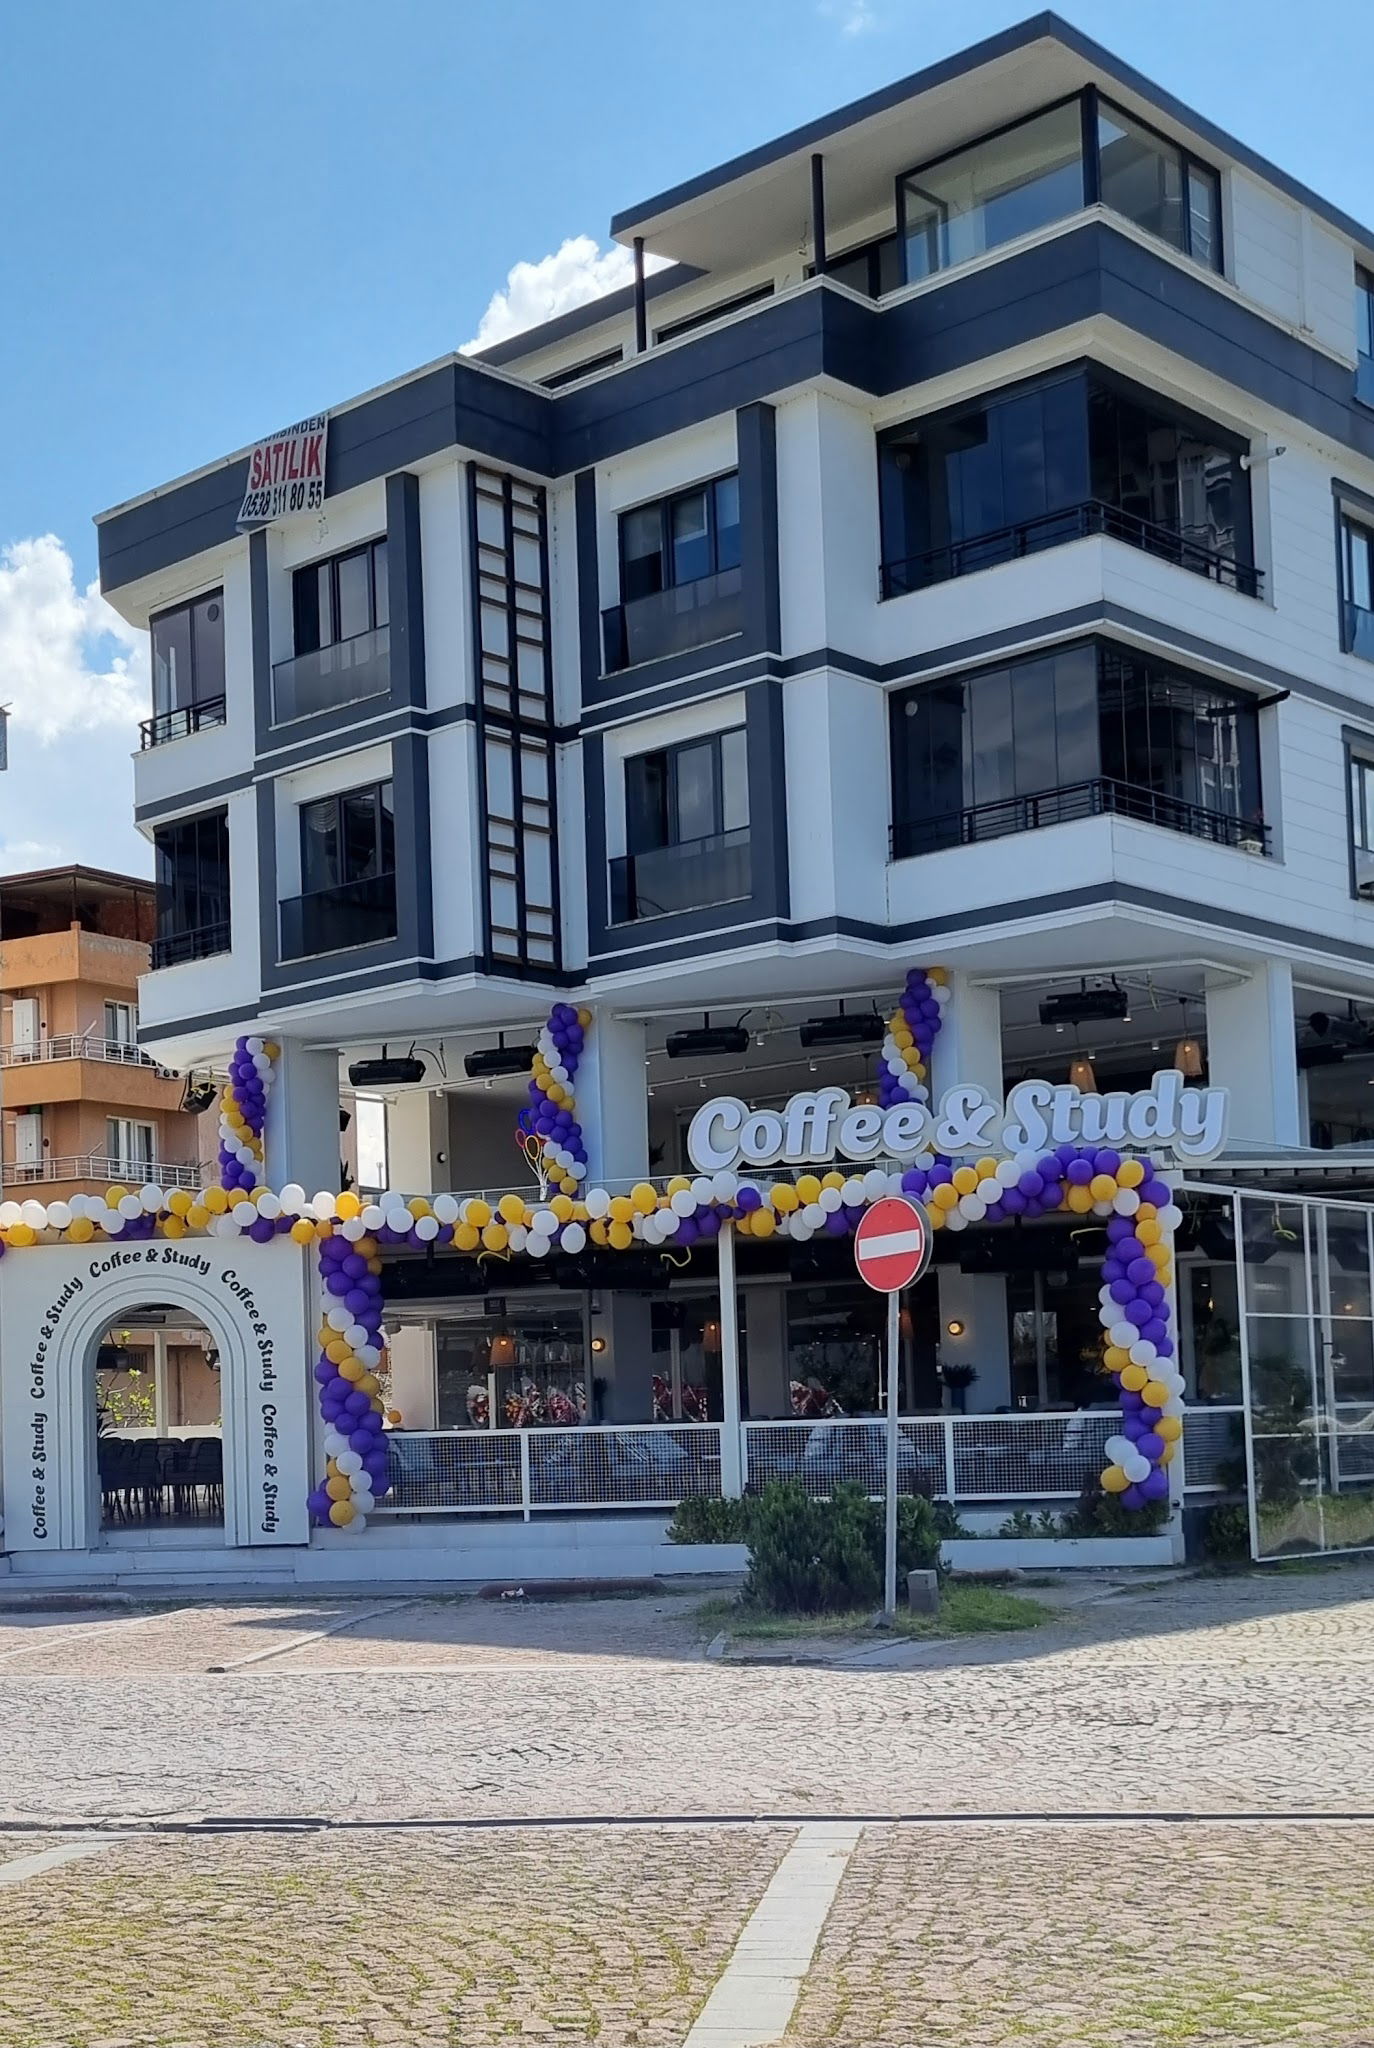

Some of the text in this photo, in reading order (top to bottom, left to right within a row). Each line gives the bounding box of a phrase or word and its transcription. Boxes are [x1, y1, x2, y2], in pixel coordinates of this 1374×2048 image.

[250, 434, 323, 490] SATILIK
[289, 482, 305, 511] 80
[307, 480, 323, 510] 55
[697, 1073, 1227, 1165] Coffee & Study
[89, 1247, 211, 1278] Coffee & Study
[30, 1277, 83, 1399] Coffee & Study
[221, 1269, 277, 1391] Coffee & Study
[30, 1412, 48, 1539] Coffee & Study
[261, 1404, 280, 1533] Coffee & Study
